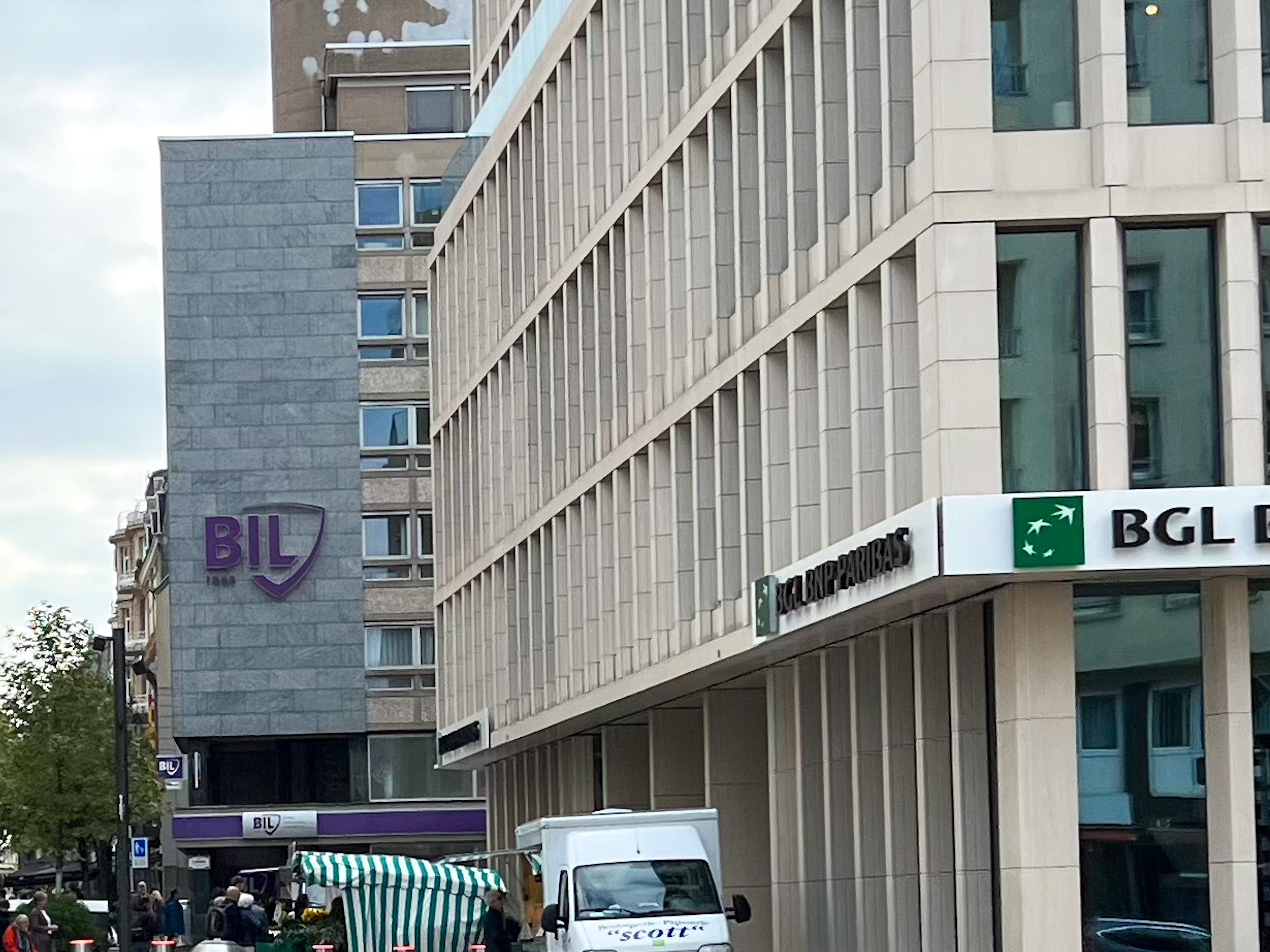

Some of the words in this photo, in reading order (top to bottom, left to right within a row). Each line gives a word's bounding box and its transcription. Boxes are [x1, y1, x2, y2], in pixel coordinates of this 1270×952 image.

[205, 514, 298, 570] BIL
[1111, 506, 1235, 548] BGL
[776, 575, 807, 615] BGL
[805, 560, 837, 602] BNP
[836, 527, 912, 590] PARIBAS
[253, 817, 274, 829] BIL
